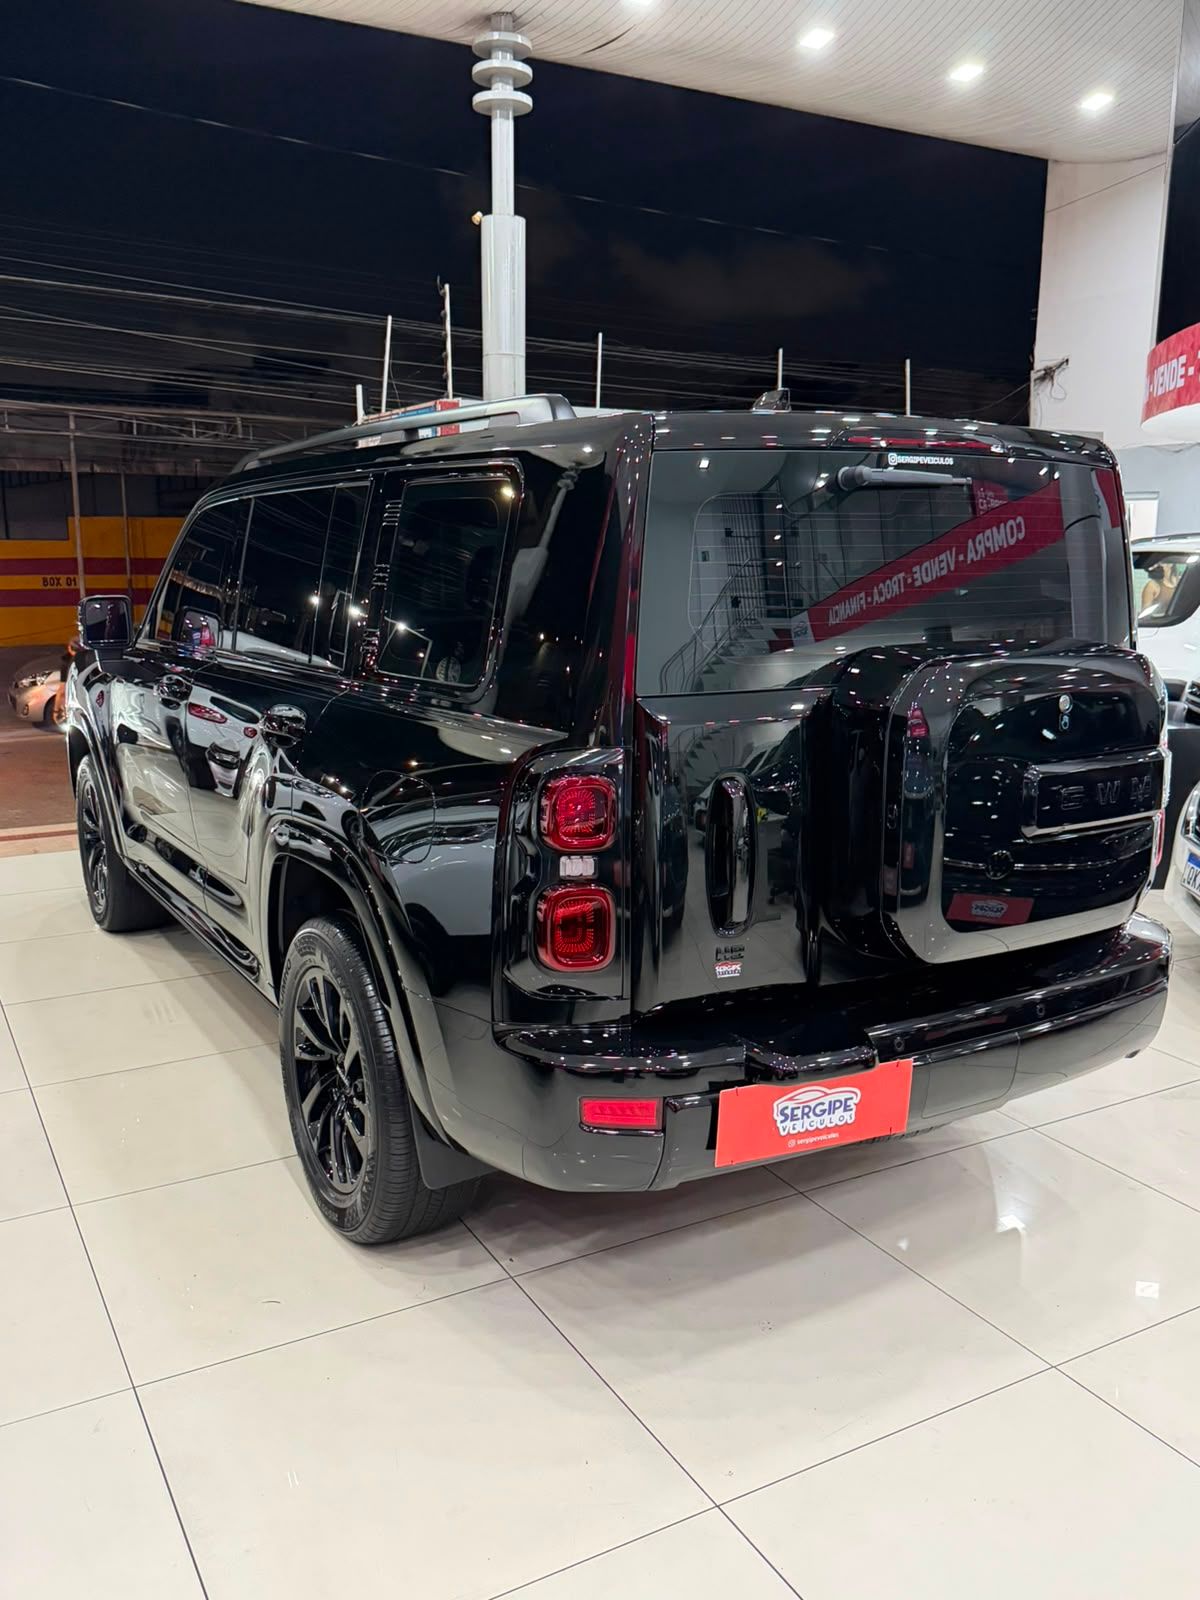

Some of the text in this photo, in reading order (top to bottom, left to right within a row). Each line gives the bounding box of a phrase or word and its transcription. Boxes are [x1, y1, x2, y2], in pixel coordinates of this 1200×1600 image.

[1153, 354, 1187, 397] VENDE
[42, 576, 77, 587] BOX 01
[780, 1097, 854, 1124] SERGIPE
